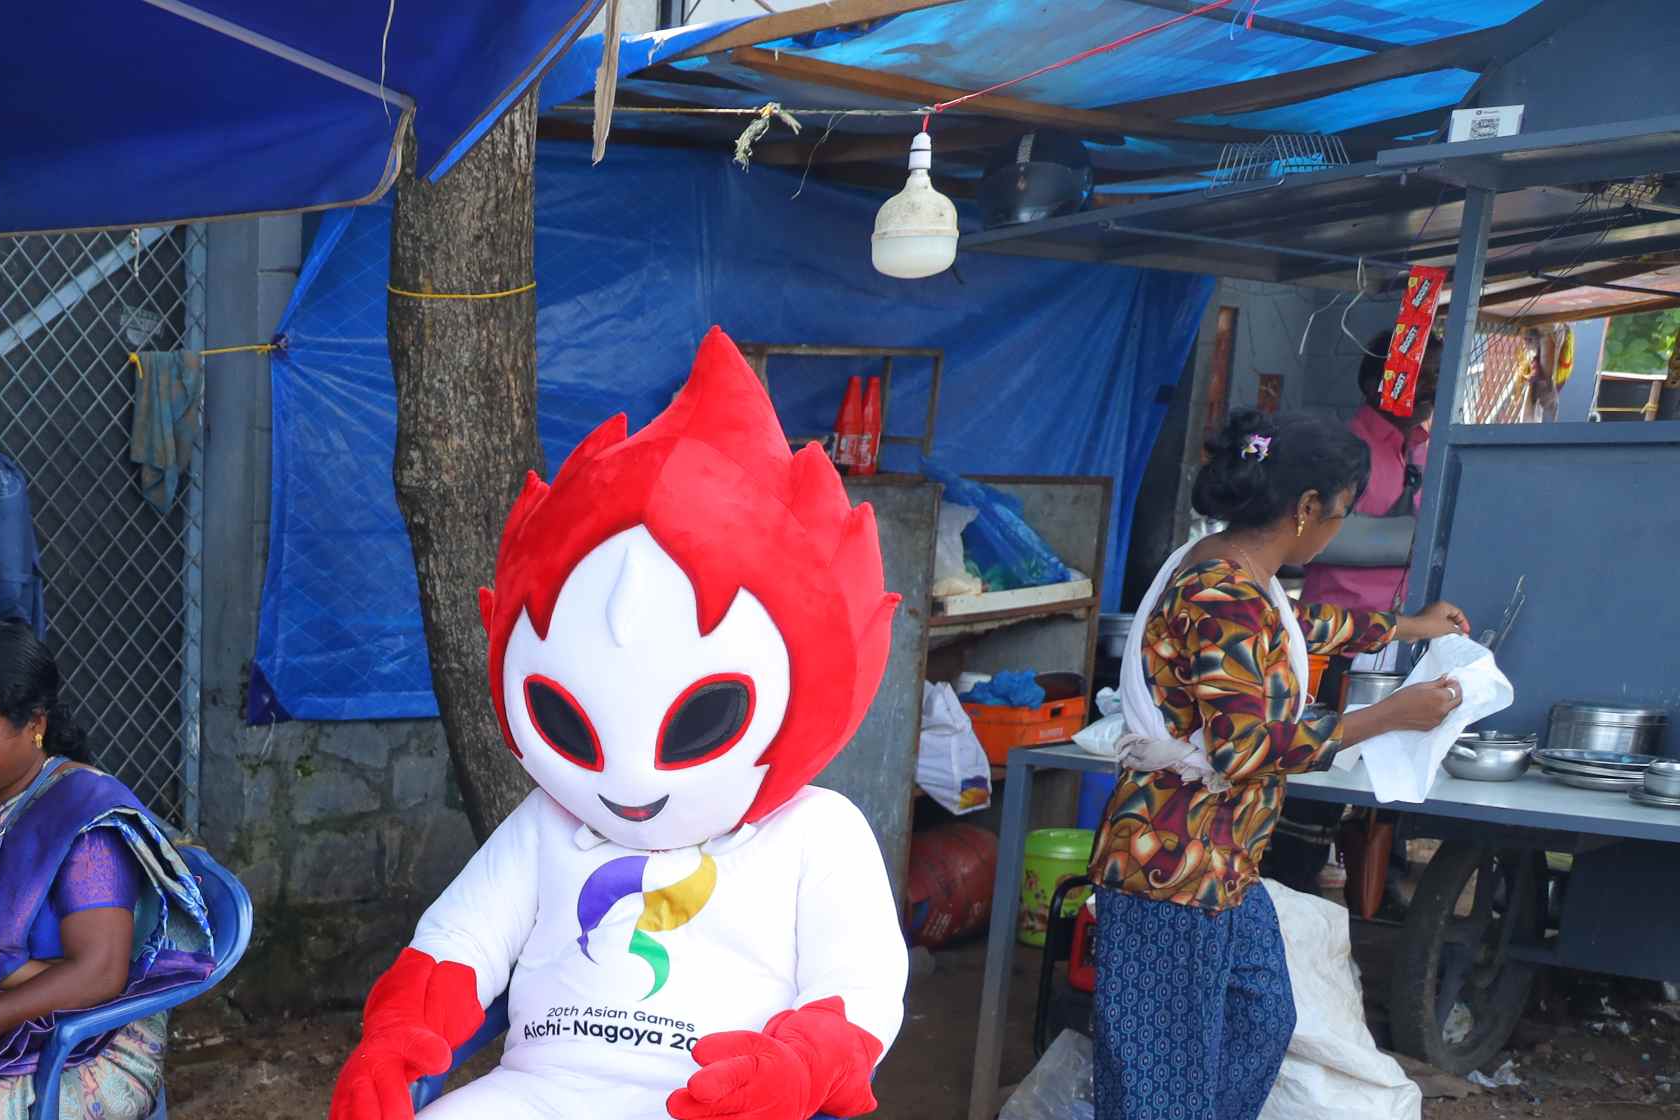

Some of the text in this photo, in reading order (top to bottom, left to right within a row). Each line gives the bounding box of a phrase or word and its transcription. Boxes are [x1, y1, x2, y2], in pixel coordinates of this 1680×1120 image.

[523, 1019, 663, 1046] Aichi-Nagoya
[546, 1005, 696, 1033] 20th Asian Games
